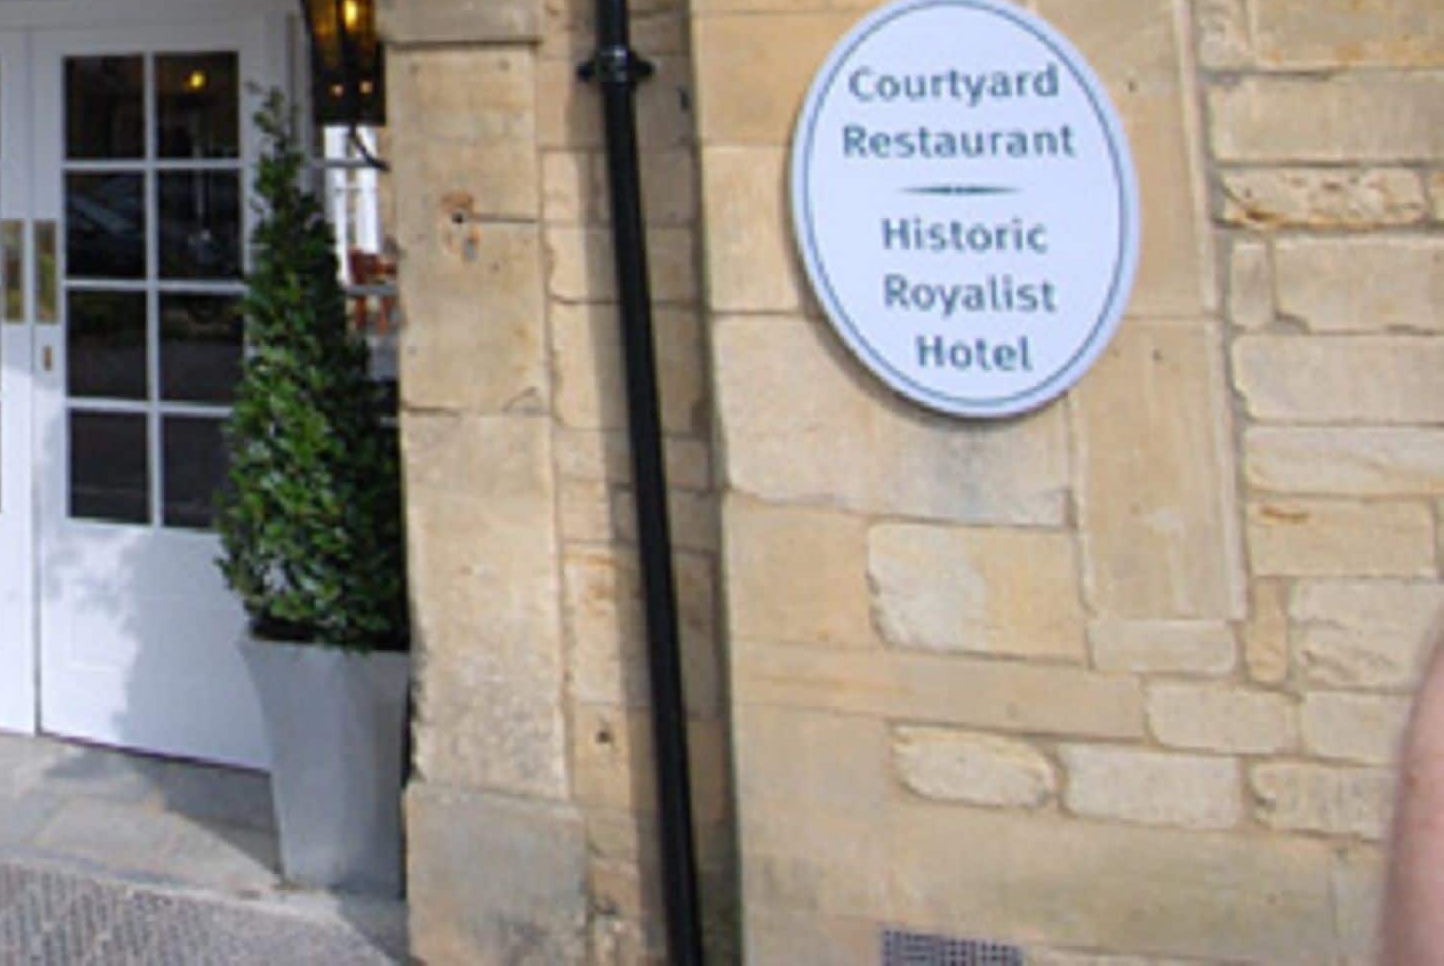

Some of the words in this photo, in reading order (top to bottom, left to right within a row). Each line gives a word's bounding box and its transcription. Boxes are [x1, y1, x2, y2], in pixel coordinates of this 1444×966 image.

[847, 63, 1059, 107] Courtyard
[842, 125, 1077, 158] Restaurant
[881, 217, 1049, 252] Historic
[882, 274, 1058, 319] Royalist
[916, 336, 1032, 372] Hotel
